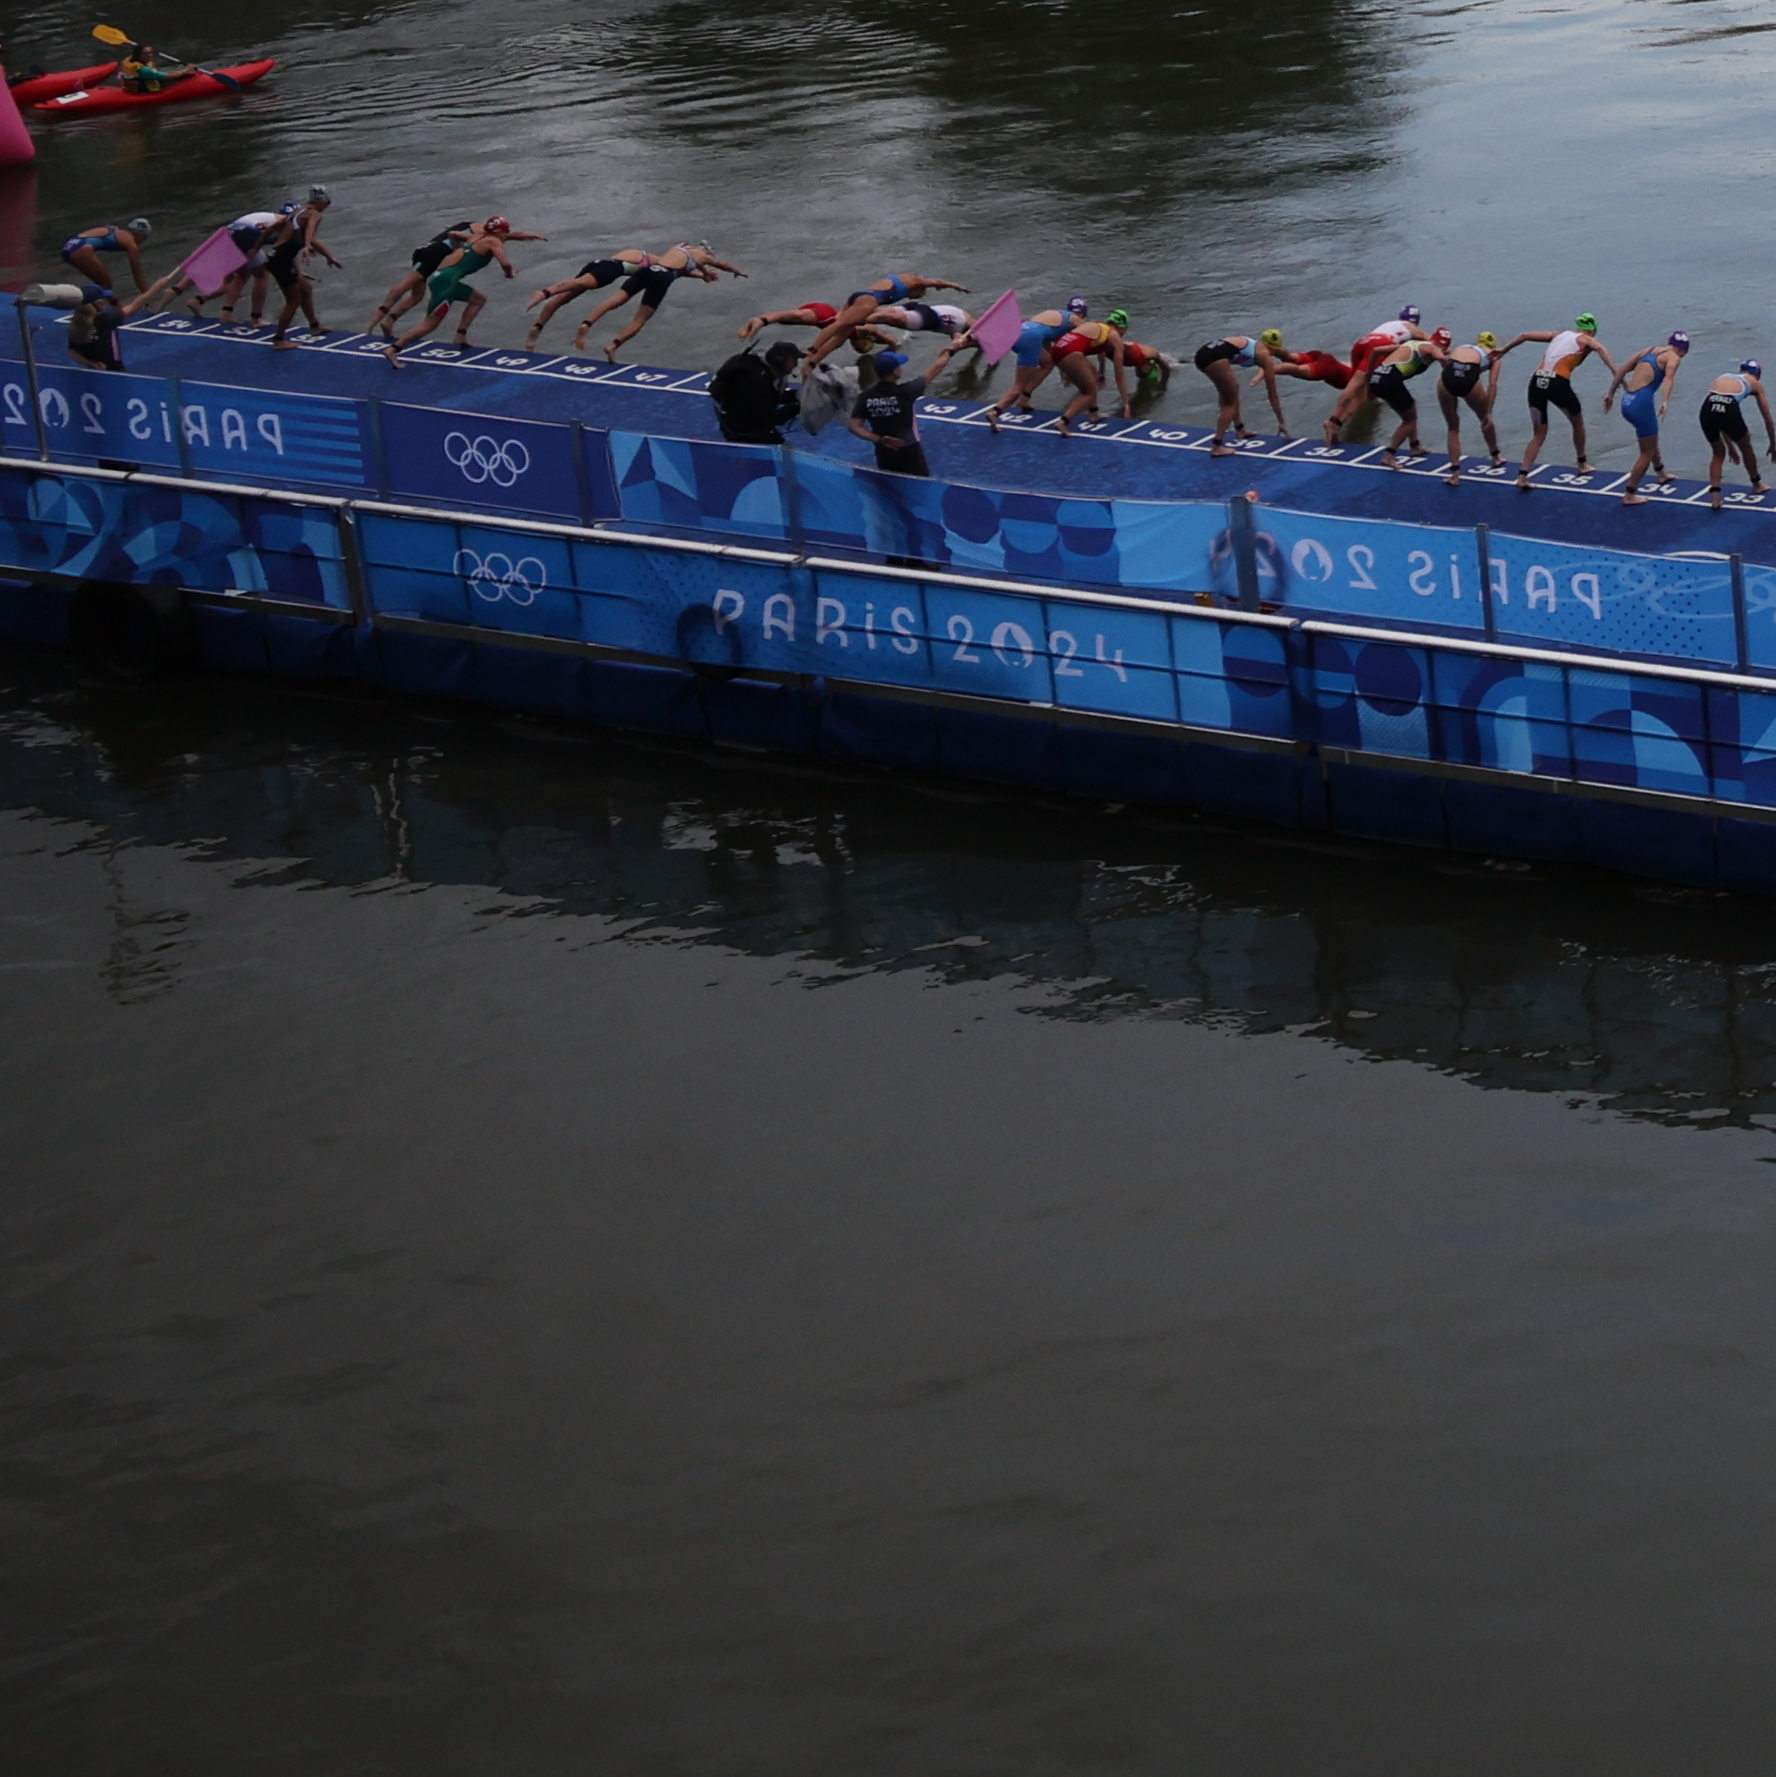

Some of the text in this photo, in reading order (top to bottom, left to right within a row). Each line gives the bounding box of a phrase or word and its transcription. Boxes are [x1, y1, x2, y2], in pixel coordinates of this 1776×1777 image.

[420, 349, 461, 358] 50
[496, 357, 528, 366] 49
[565, 364, 596, 374] 48
[636, 373, 668, 382] 47
[866, 396, 899, 408] PARIS
[924, 404, 956, 413] 43
[1711, 403, 1726, 414] FRA
[1150, 429, 1188, 440] 40
[1226, 440, 1265, 448] 39
[1305, 448, 1344, 456] 38
[1468, 466, 1506, 475] 36
[1552, 474, 1592, 485] 35
[1638, 484, 1676, 494] 34
[1724, 493, 1764, 503] 33
[947, 614, 1128, 683] 2024
